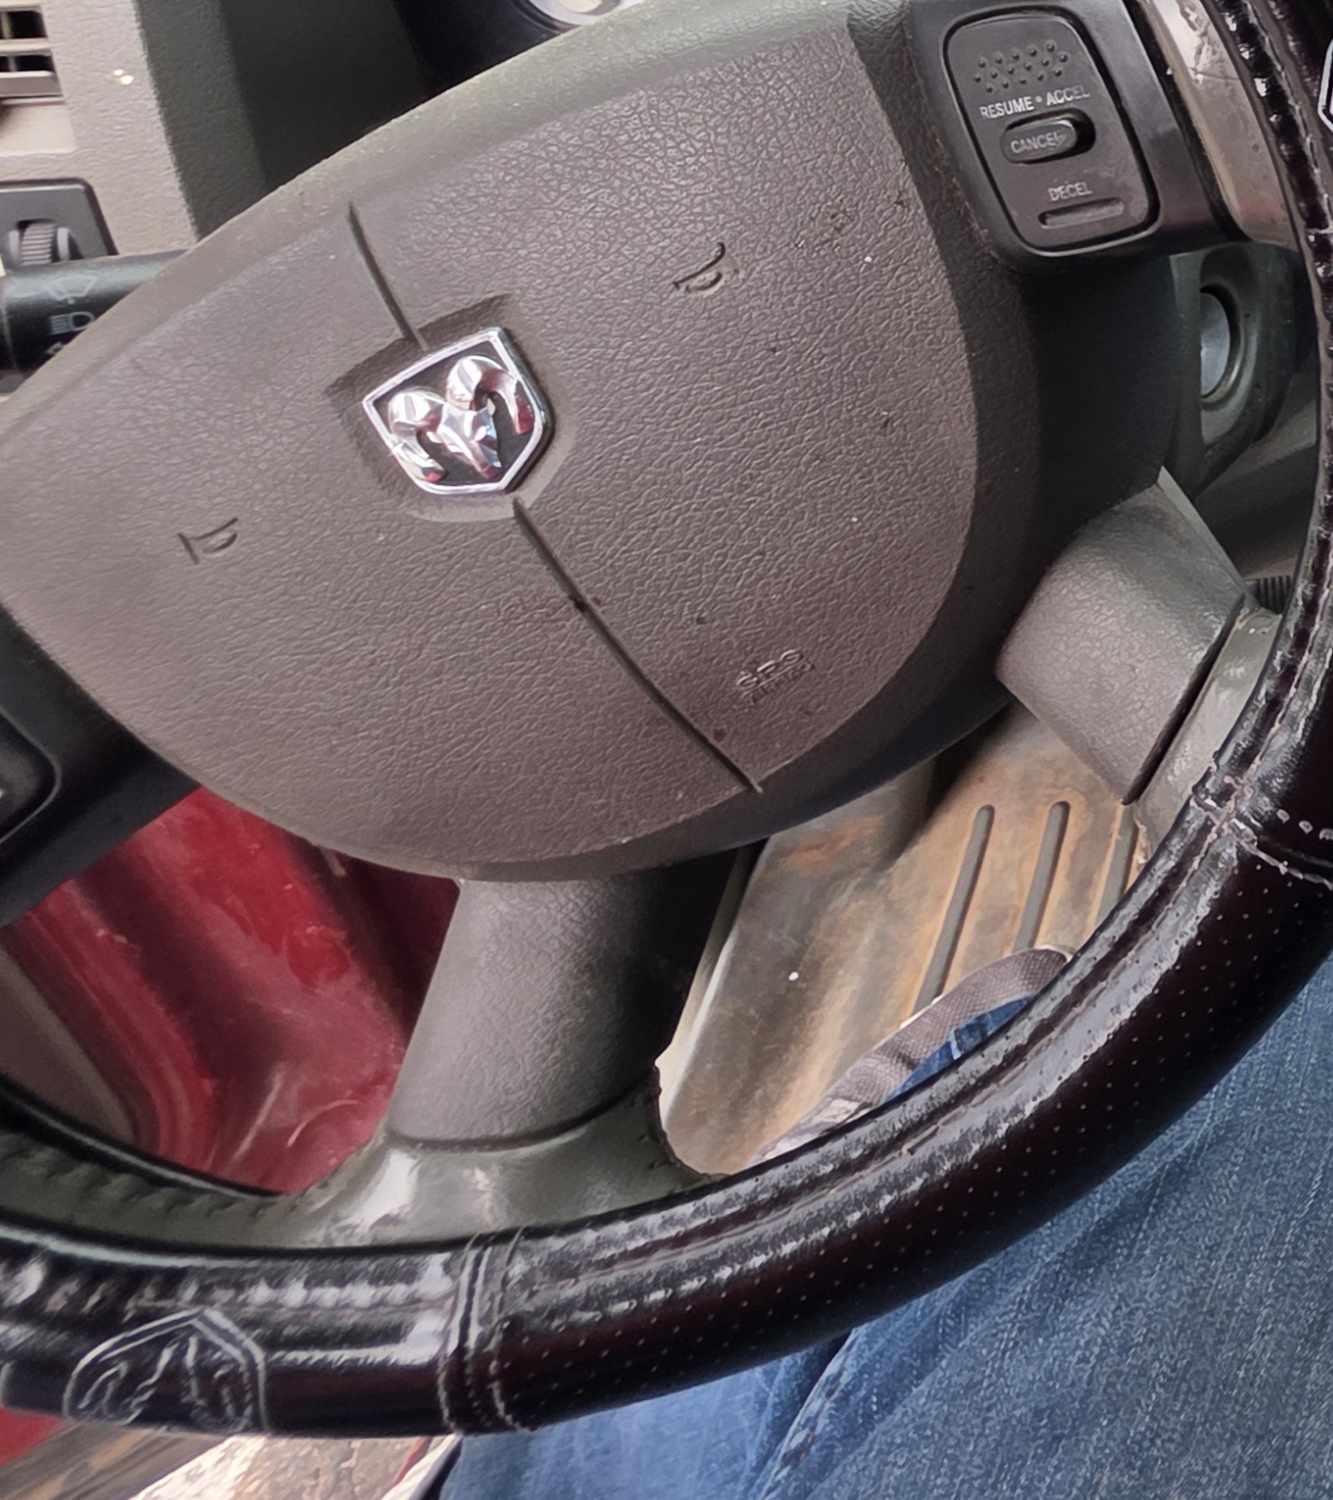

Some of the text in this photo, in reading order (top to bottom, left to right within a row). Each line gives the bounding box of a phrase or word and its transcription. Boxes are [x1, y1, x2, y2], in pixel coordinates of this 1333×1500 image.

[980, 84, 1091, 119] RESUME ACCEL
[1010, 131, 1067, 153] CANCEL
[1047, 181, 1093, 201] DECEL
